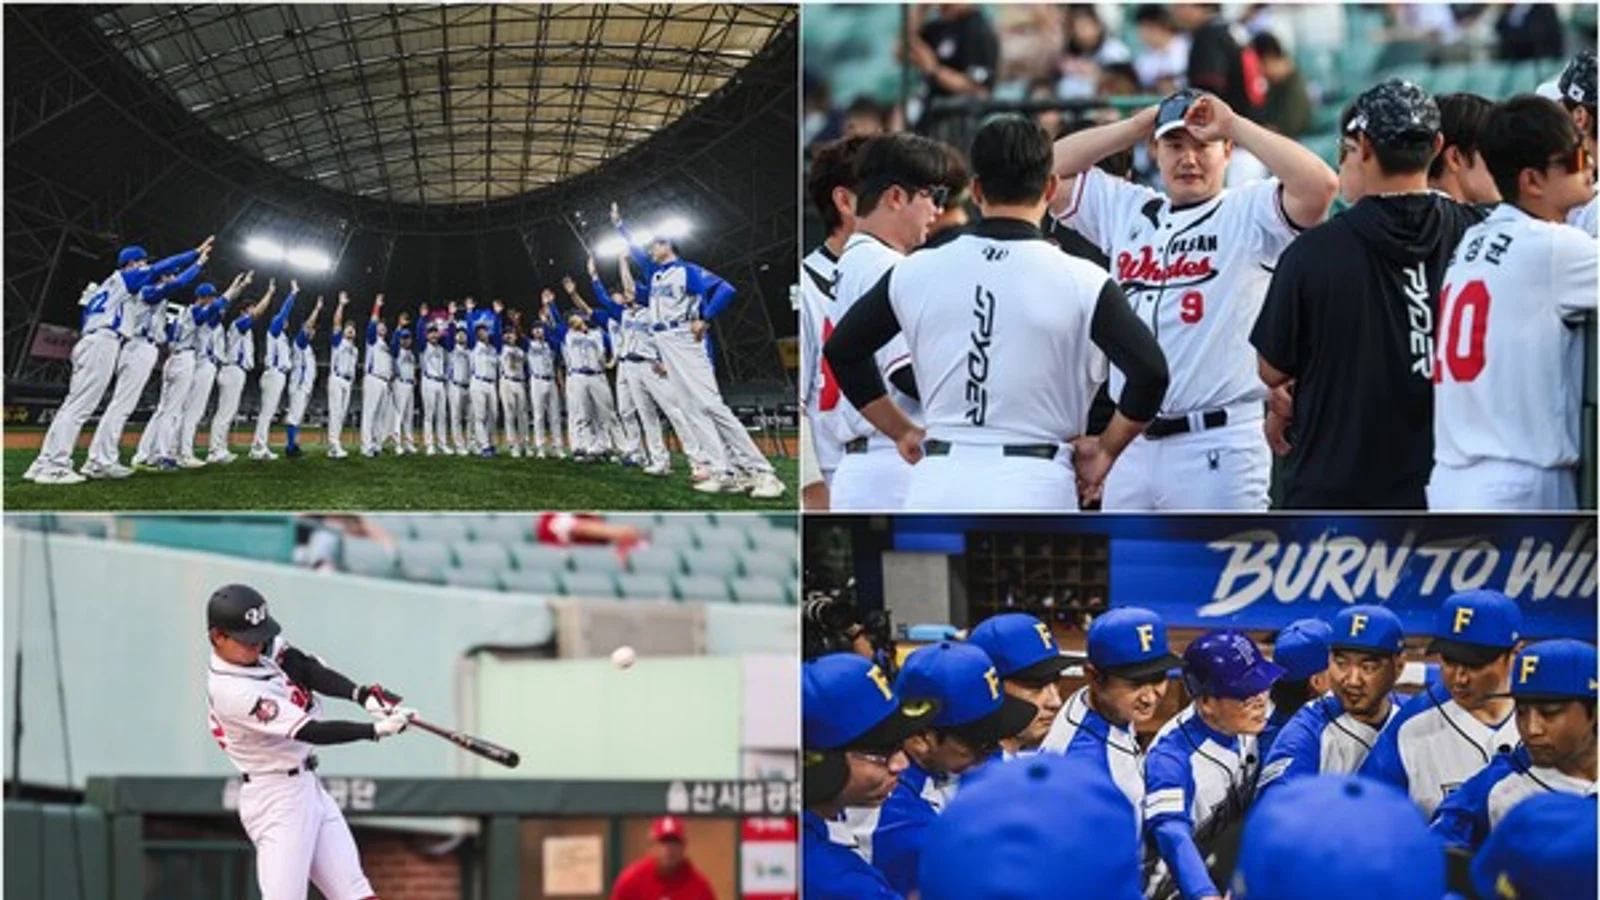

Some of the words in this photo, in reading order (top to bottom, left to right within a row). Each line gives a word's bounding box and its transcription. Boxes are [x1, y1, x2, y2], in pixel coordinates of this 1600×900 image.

[1181, 291, 1204, 324] 9
[1403, 261, 1435, 380] PYDER
[965, 284, 996, 427] SPYDER
[1196, 530, 1414, 617] BURN
[1416, 535, 1499, 596] TO
[1033, 621, 1053, 650] F
[1350, 613, 1369, 637] F
[1452, 606, 1475, 634] F
[1136, 623, 1154, 652] F
[866, 663, 893, 701] F
[983, 665, 1000, 701] F
[1518, 655, 1540, 684] F
